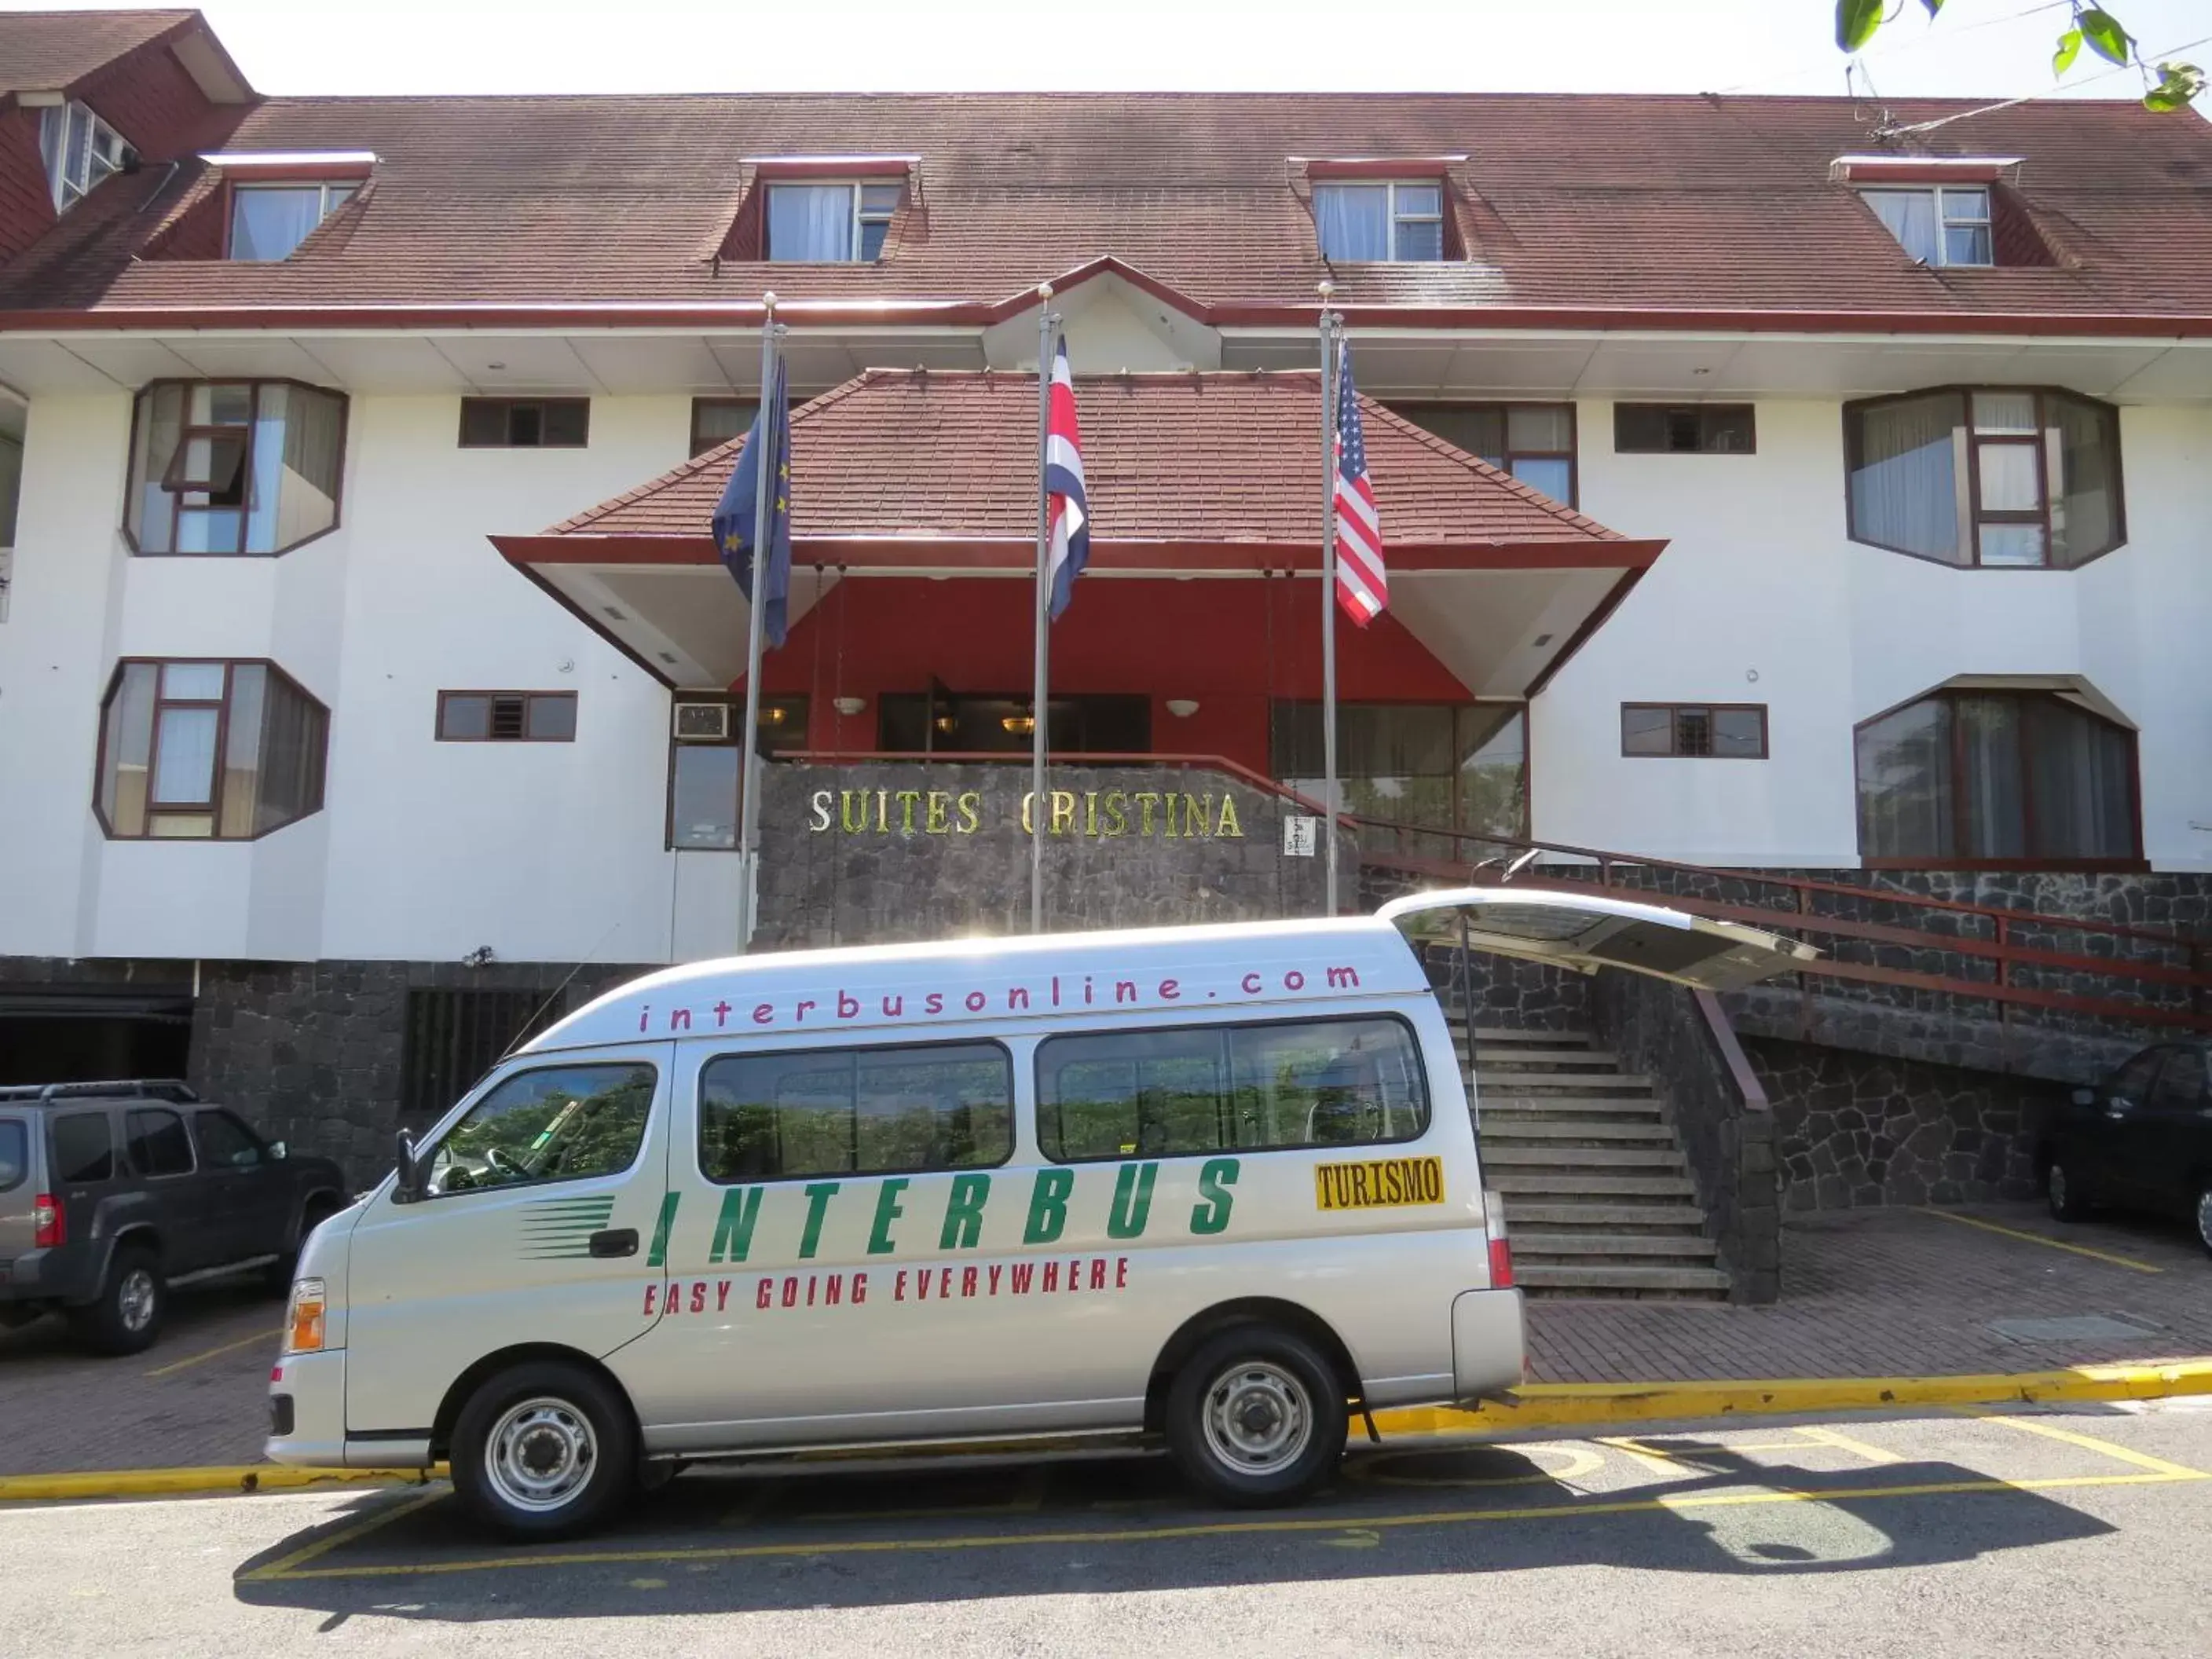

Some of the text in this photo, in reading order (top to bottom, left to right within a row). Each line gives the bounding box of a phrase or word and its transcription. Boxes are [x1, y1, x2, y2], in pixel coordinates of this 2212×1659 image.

[809, 789, 982, 836] SUITES
[1022, 790, 1244, 838] CRISTINA
[638, 961, 1361, 1033] interbusonline.com
[646, 1156, 1240, 1268] INTERBUS
[1318, 1159, 1441, 1210] TURISMO
[644, 1257, 1130, 1316] EASY GOING EVERYWHERE
